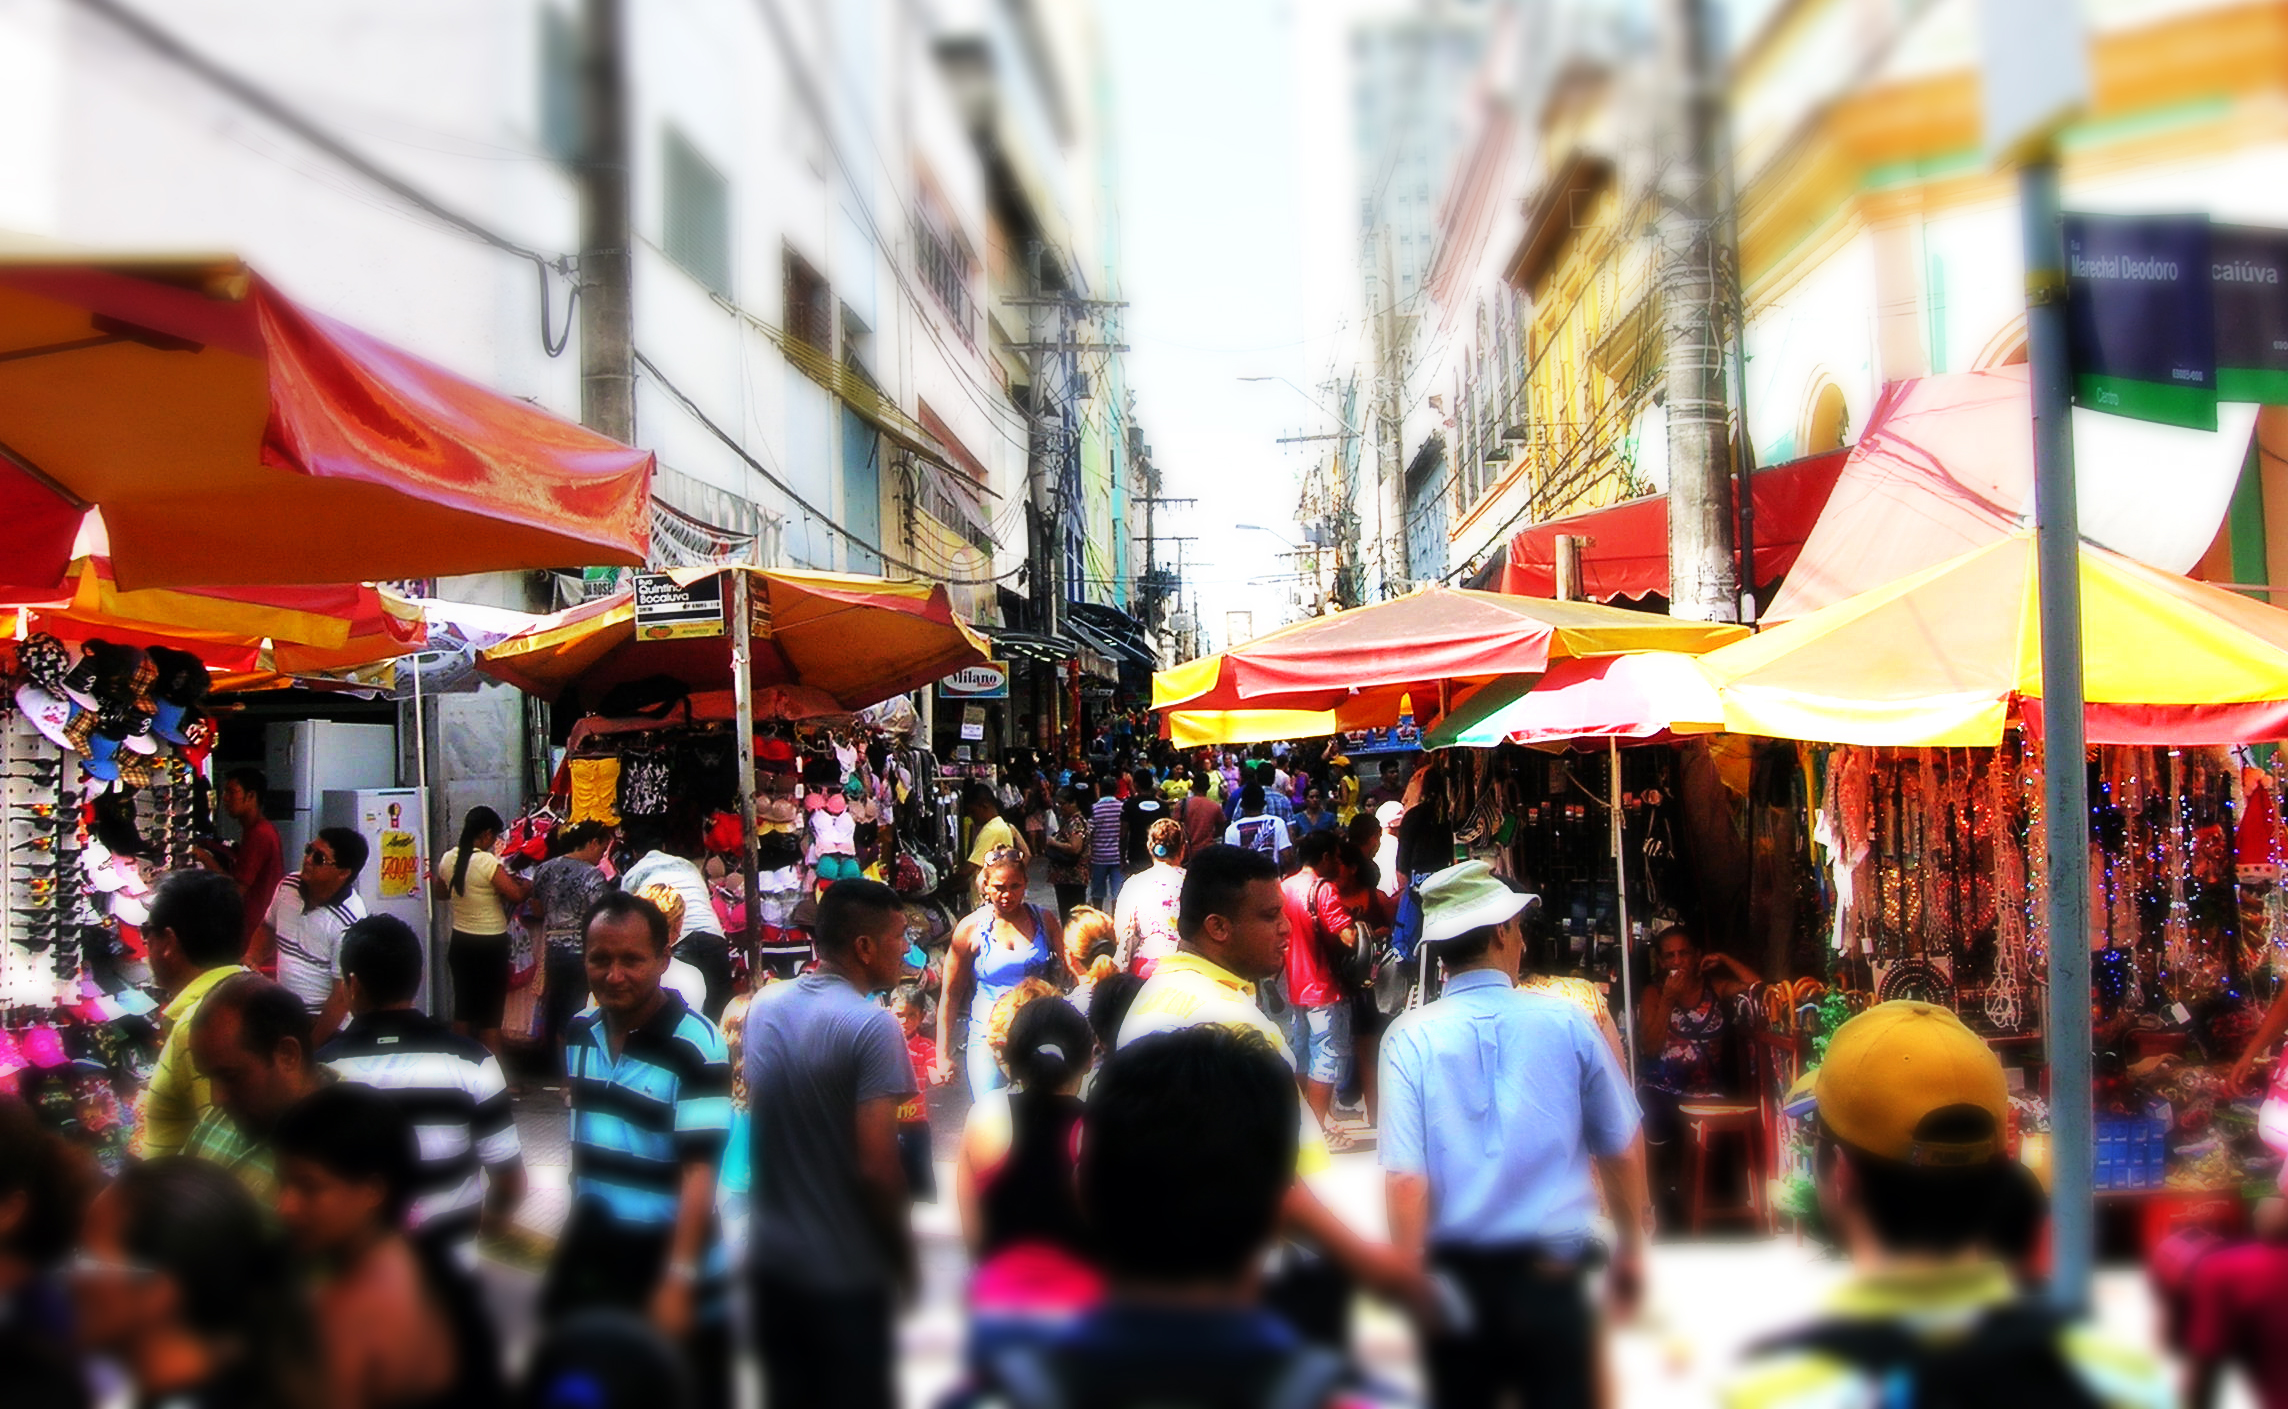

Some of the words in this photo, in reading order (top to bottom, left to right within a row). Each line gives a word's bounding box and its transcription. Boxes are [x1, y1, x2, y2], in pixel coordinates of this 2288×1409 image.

[2071, 254, 2119, 279] Marechal
[2122, 255, 2179, 281] Deodoro
[2212, 260, 2279, 284] caiúva
[2096, 386, 2120, 406] Centro
[638, 578, 653, 586] Rua
[638, 583, 682, 595] Quintino
[953, 671, 997, 683] Milano
